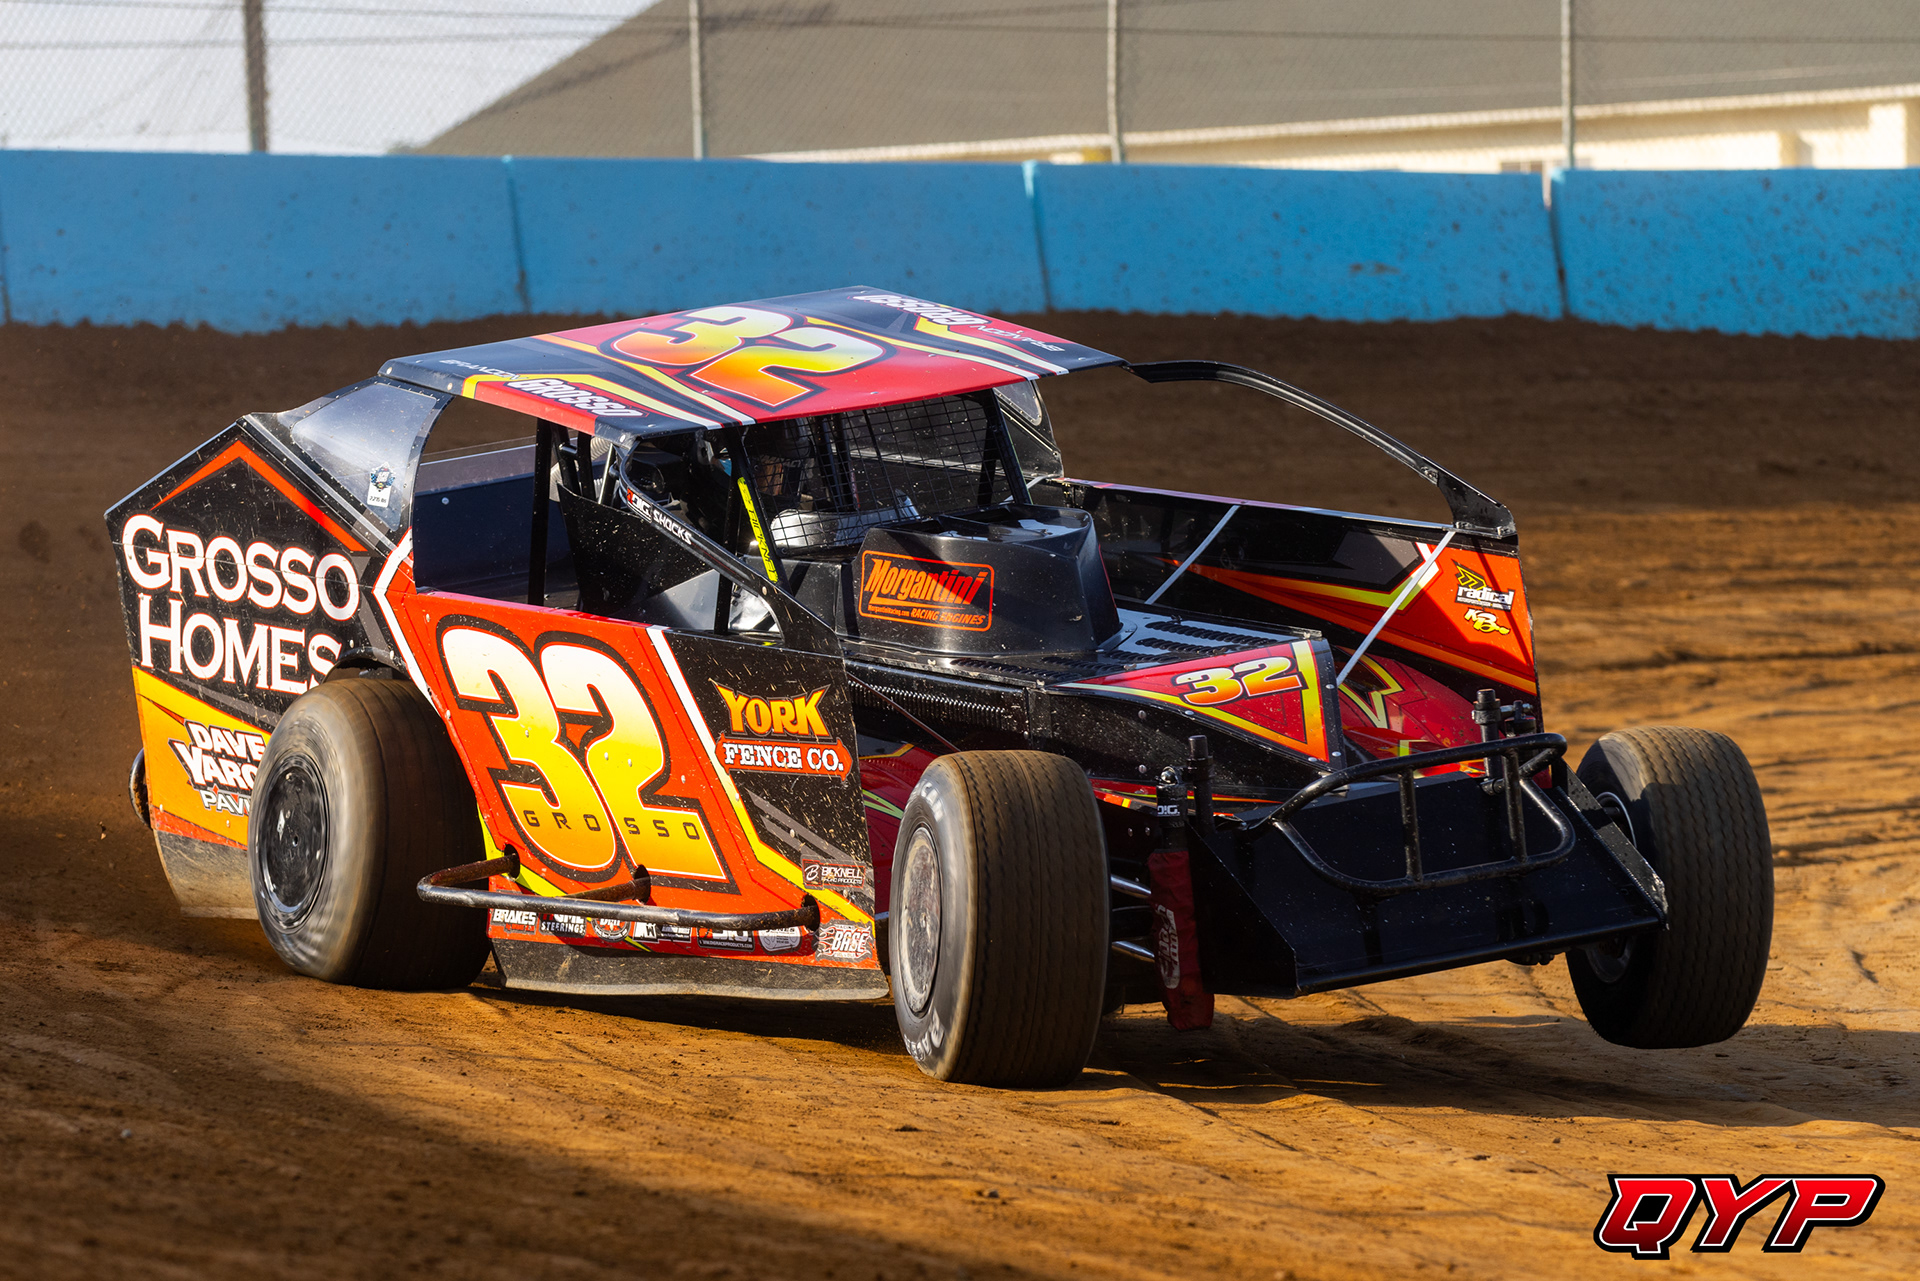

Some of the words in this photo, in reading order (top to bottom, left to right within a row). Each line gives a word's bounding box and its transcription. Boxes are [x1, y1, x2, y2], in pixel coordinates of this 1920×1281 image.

[611, 305, 885, 408] 32
[506, 377, 646, 418] GROSSO
[653, 511, 692, 546] SHOCKS
[122, 513, 360, 621] GROSSO
[864, 557, 989, 605] Morgantini
[910, 607, 940, 622] RACING
[939, 612, 987, 625] ENGINES
[1457, 585, 1515, 606] radical
[138, 593, 343, 696] HOMES
[1175, 656, 1304, 706] 32
[716, 684, 830, 737] YORK
[187, 722, 265, 762] DAVE
[441, 628, 727, 880] 32
[722, 743, 803, 769] FENCE
[806, 747, 845, 772] CO.
[523, 810, 701, 841] GROSSO
[493, 908, 537, 926] BRAKES
